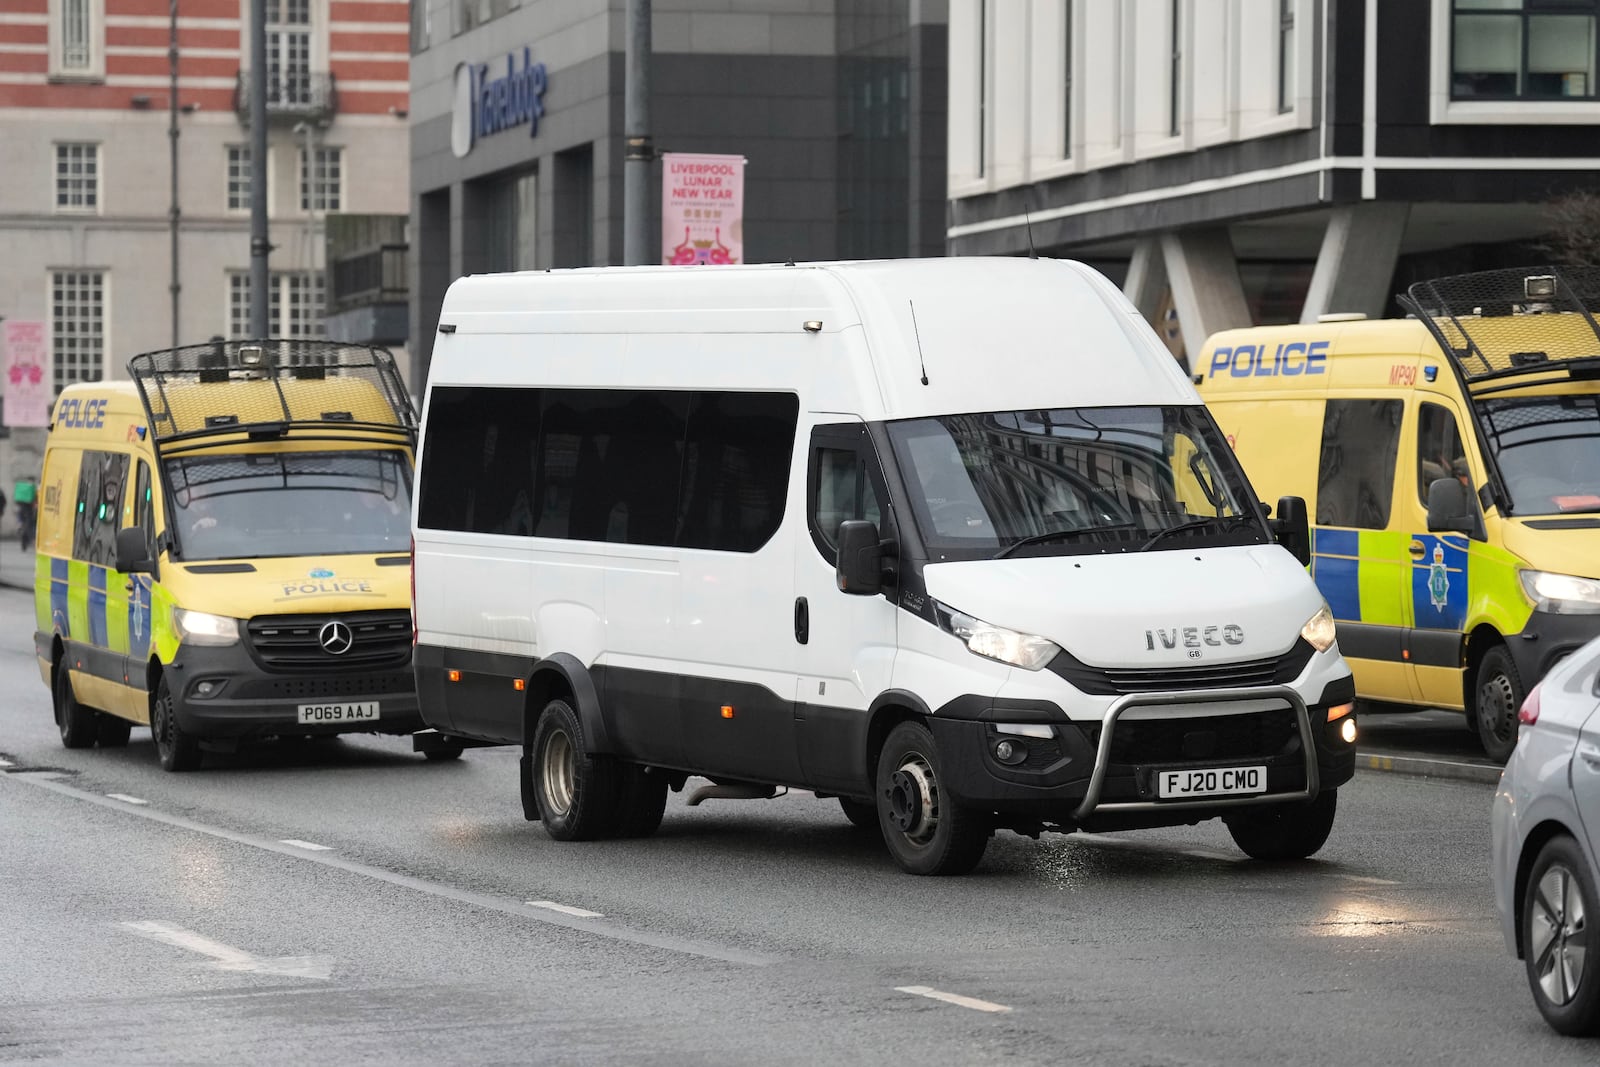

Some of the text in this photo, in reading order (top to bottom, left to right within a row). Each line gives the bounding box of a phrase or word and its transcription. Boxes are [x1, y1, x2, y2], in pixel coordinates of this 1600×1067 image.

[671, 162, 735, 176] LIVERPOOL
[683, 176, 722, 187] LUNAR
[672, 188, 733, 200] NEW YEAR
[1208, 341, 1330, 379] POLICE
[1389, 365, 1417, 386] MP90
[57, 399, 108, 429] POLICE
[283, 582, 373, 596] POLICE
[1145, 624, 1245, 651] IVECO
[1189, 650, 1201, 658] GB
[305, 703, 373, 721] PO69 AAJ
[1167, 769, 1258, 793] FJ20 CMO
